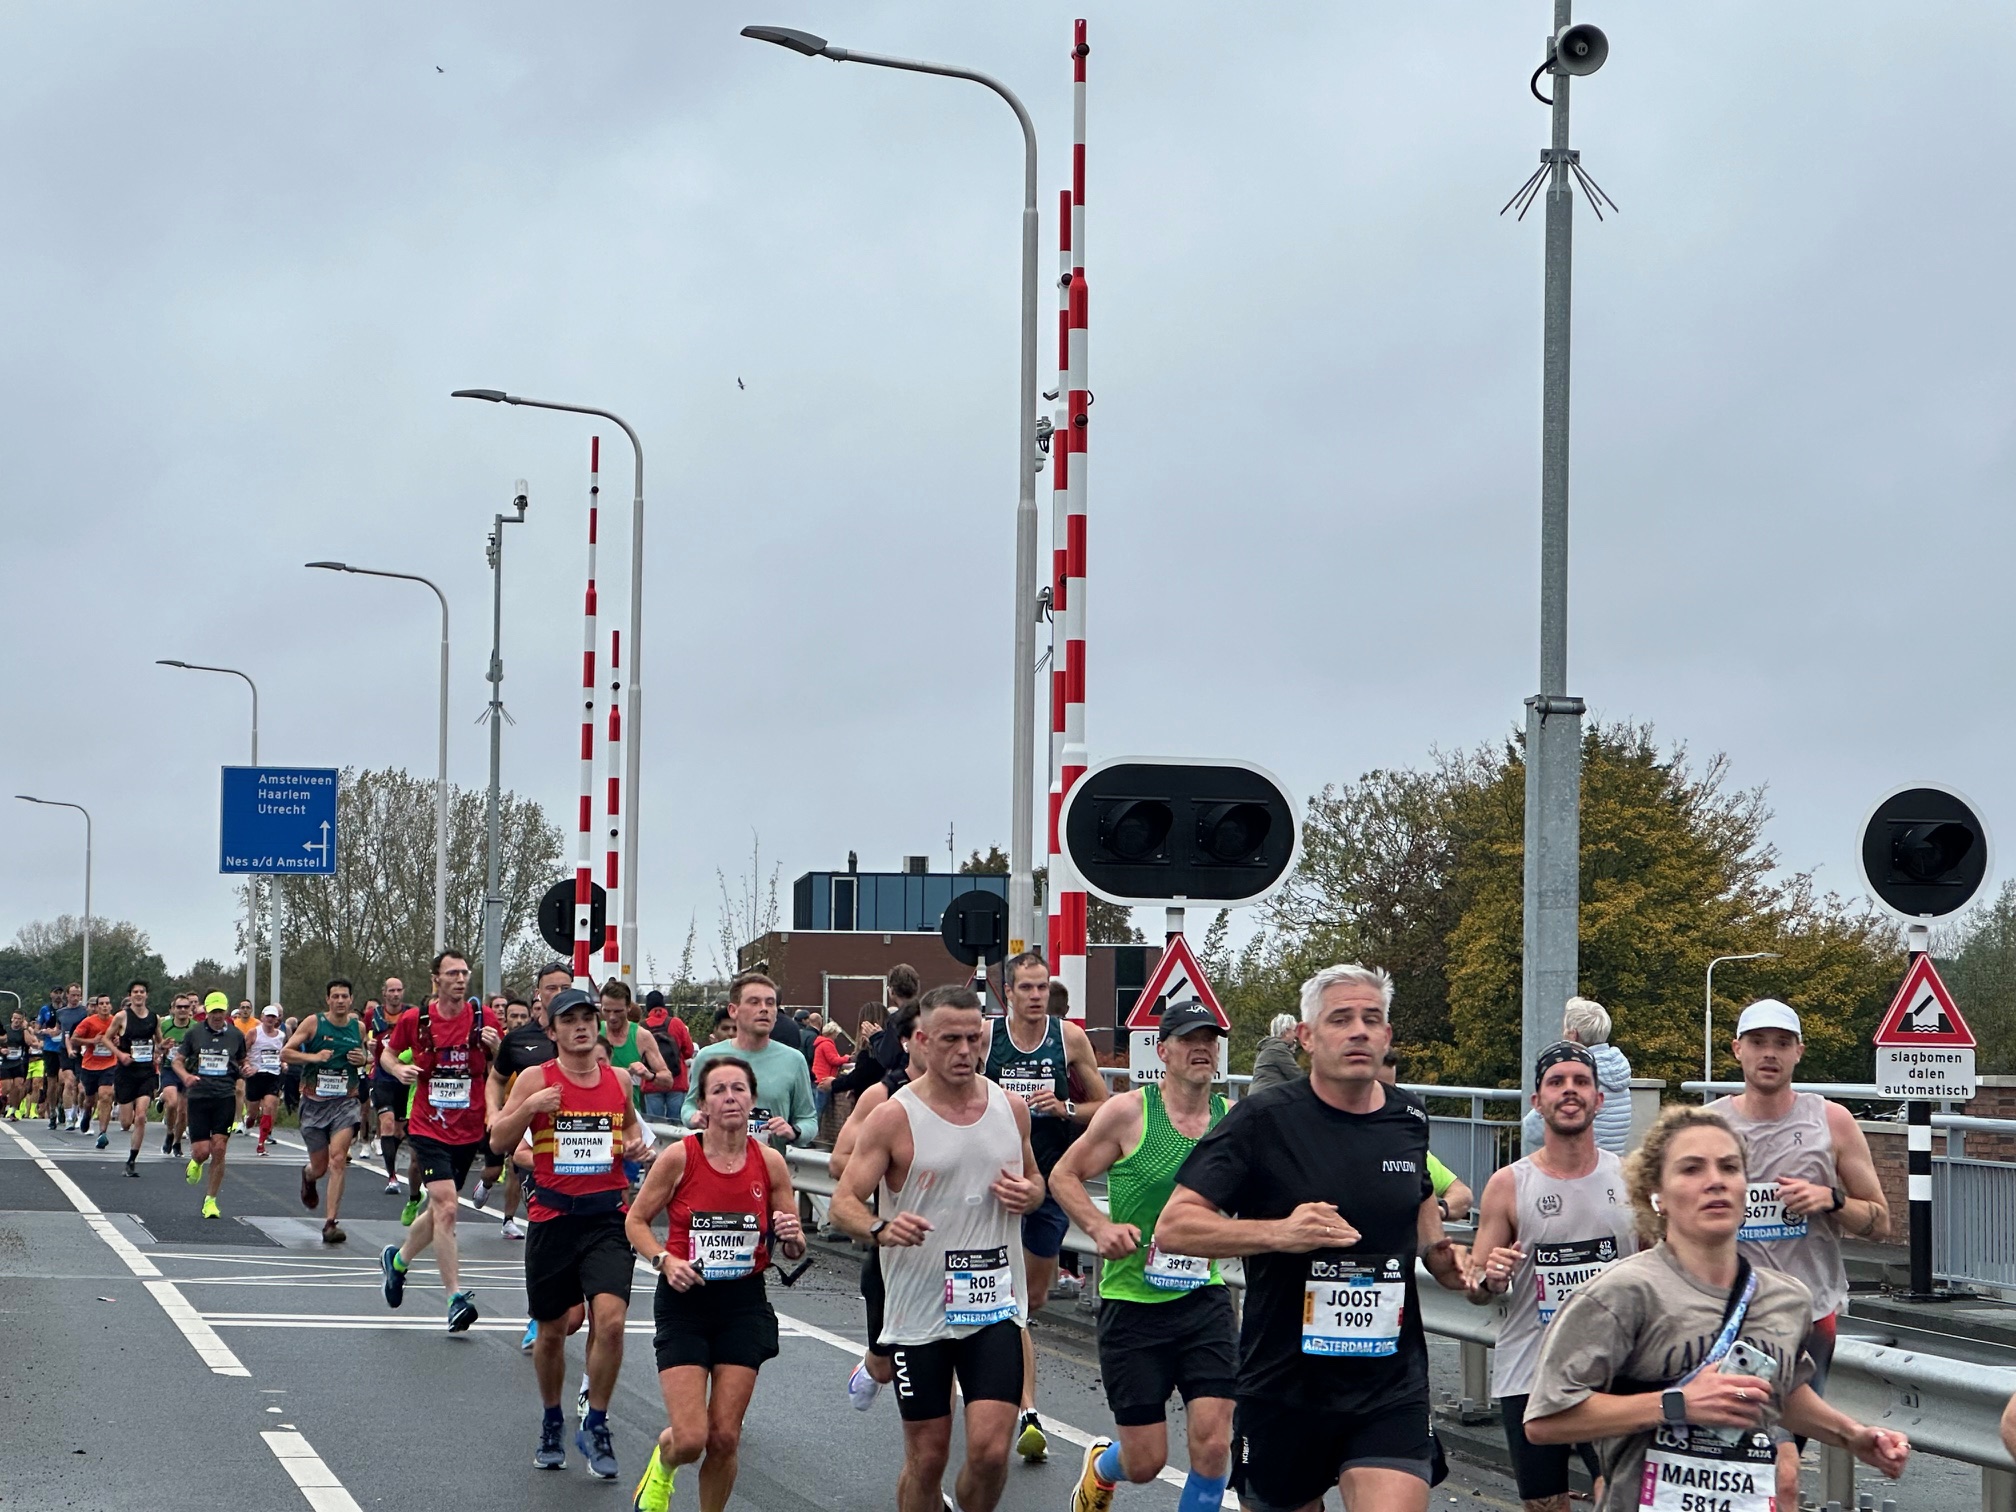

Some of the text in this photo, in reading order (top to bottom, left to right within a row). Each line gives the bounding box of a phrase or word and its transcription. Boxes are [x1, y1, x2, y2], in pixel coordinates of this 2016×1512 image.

[258, 774, 332, 786] Amstelveen
[258, 788, 311, 800] Haarlem
[258, 804, 306, 815] Utrecht
[226, 856, 319, 868] Nes a/d Amstel
[1891, 1051, 1962, 1066] slagbomen
[1908, 1068, 1945, 1079] dalen
[433, 1081, 464, 1090] MARTIJN
[1884, 1084, 1969, 1096] automatisch
[440, 1090, 456, 1098] 5761
[561, 1137, 603, 1146] JONATHAN
[573, 1149, 591, 1158] 974
[692, 1216, 711, 1228] tcs
[1738, 1225, 1807, 1239] STERDAM 2024
[700, 1235, 745, 1247] YASMIN
[709, 1250, 735, 1261] 4325
[1537, 1249, 1559, 1263] tcs
[1167, 1258, 1193, 1270] 3913
[970, 1276, 996, 1290] ROB
[1548, 1268, 1602, 1286] SAMUE
[968, 1291, 997, 1304] 3475
[1326, 1290, 1382, 1307] JOOST
[1334, 1312, 1374, 1327] 1909
[1747, 1448, 1772, 1459] TATA
[1661, 1463, 1755, 1494] MARISSA
[1681, 1492, 1732, 1512] 5814
